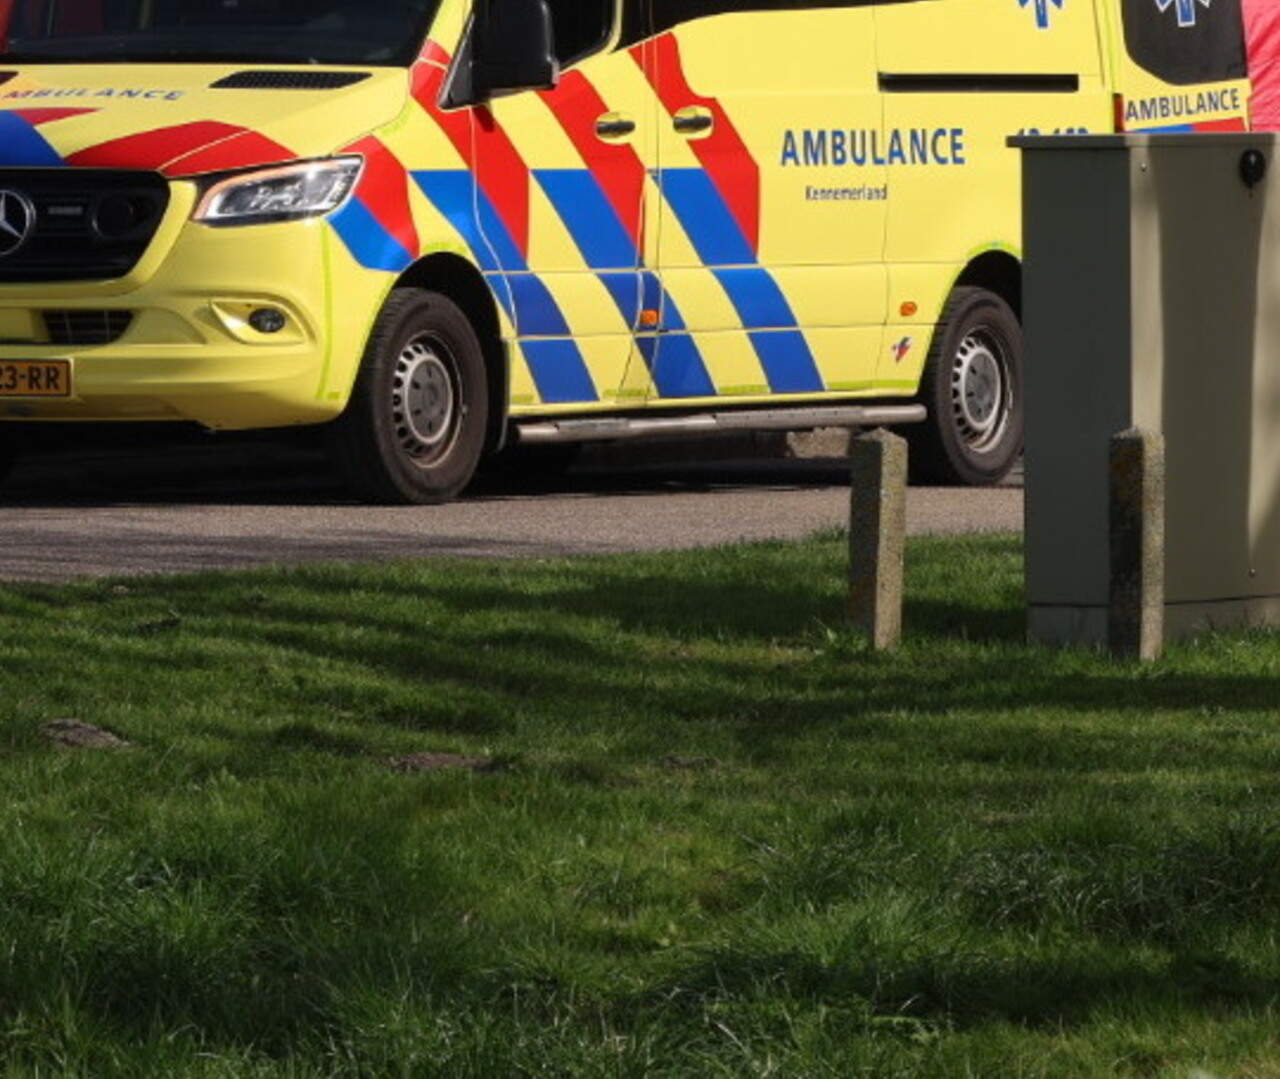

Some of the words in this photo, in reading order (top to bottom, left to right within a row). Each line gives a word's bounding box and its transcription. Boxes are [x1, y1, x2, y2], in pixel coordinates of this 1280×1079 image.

[1126, 88, 1240, 121] AMBULANCE
[780, 127, 965, 166] AMBULANCE
[805, 184, 888, 201] Kennemerland
